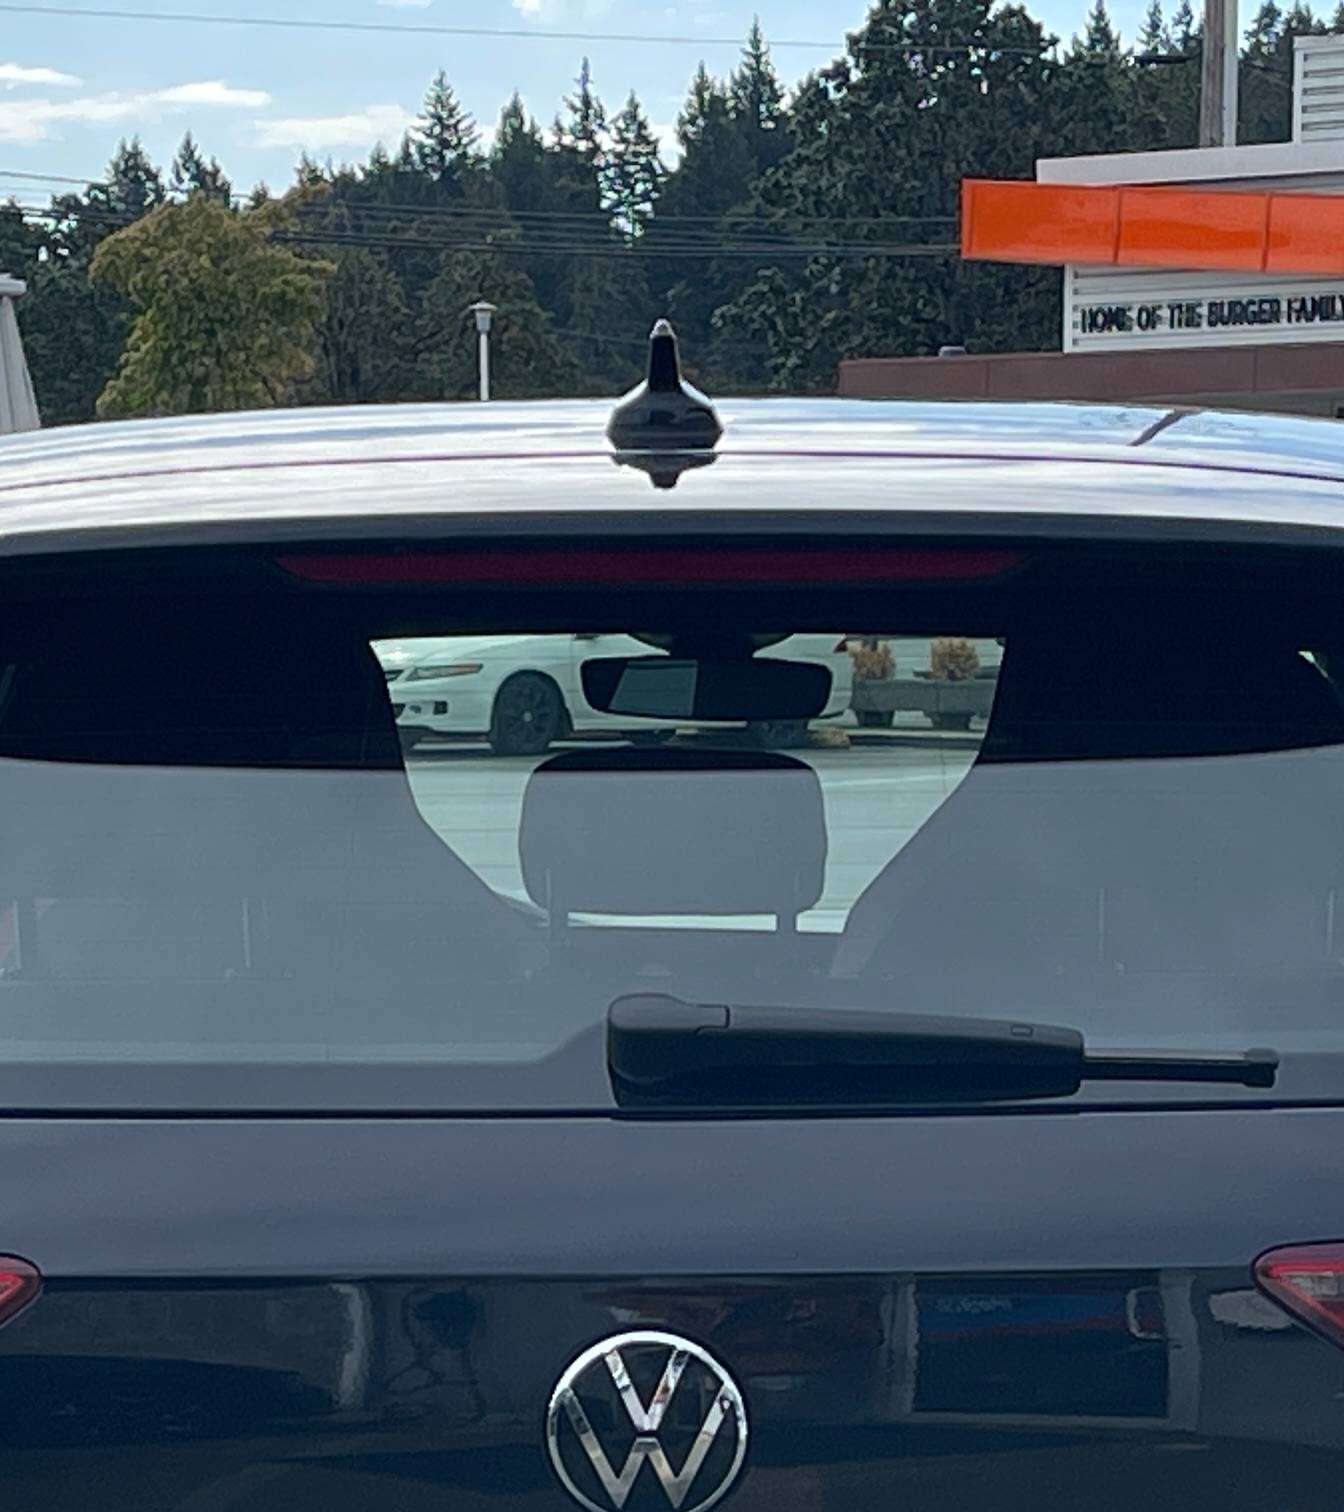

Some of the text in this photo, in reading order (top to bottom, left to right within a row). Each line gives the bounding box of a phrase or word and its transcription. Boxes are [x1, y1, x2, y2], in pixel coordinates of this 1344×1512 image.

[1081, 304, 1133, 333] HOME
[1137, 304, 1161, 331] OF
[1168, 301, 1202, 329] THE
[1207, 298, 1281, 327] BURGER
